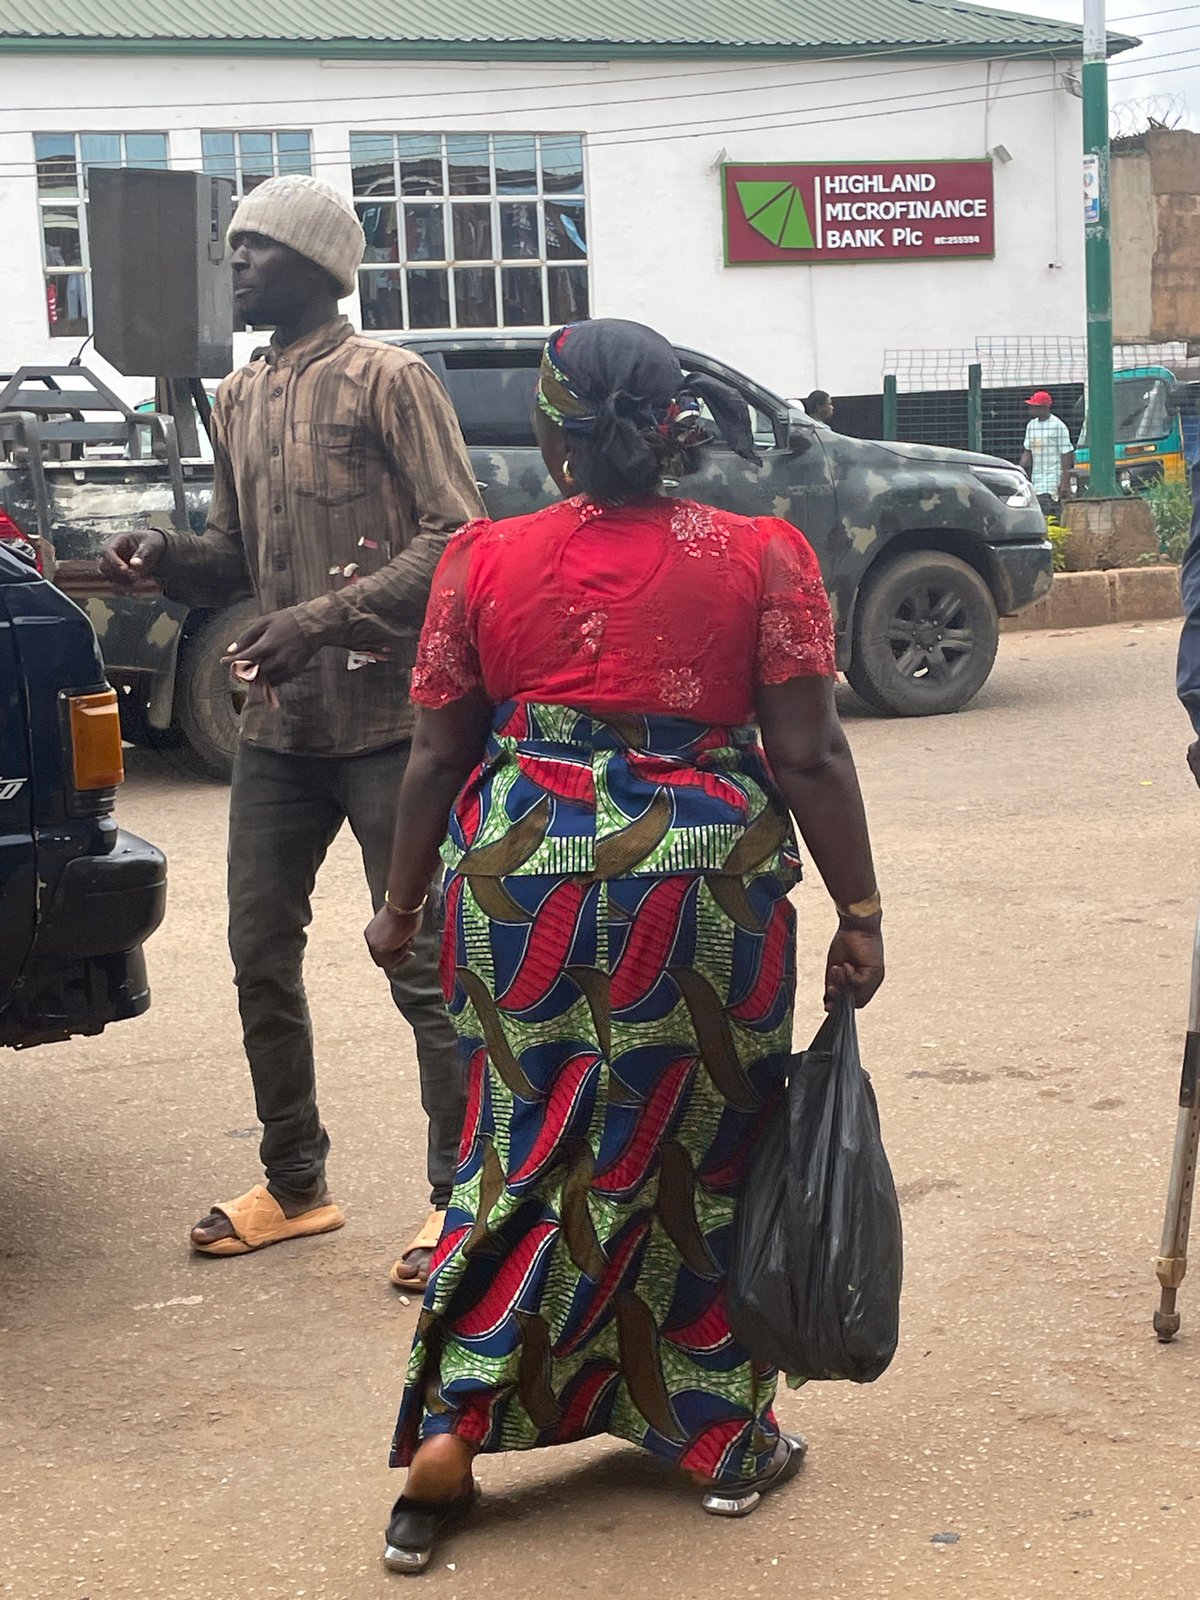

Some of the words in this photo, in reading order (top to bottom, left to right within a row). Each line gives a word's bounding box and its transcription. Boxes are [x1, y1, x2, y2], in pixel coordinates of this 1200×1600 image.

[825, 174, 936, 194] HIGHLAND
[825, 199, 987, 221] MICROFINANCE
[826, 229, 885, 248] BANK
[892, 228, 923, 246] Plc
